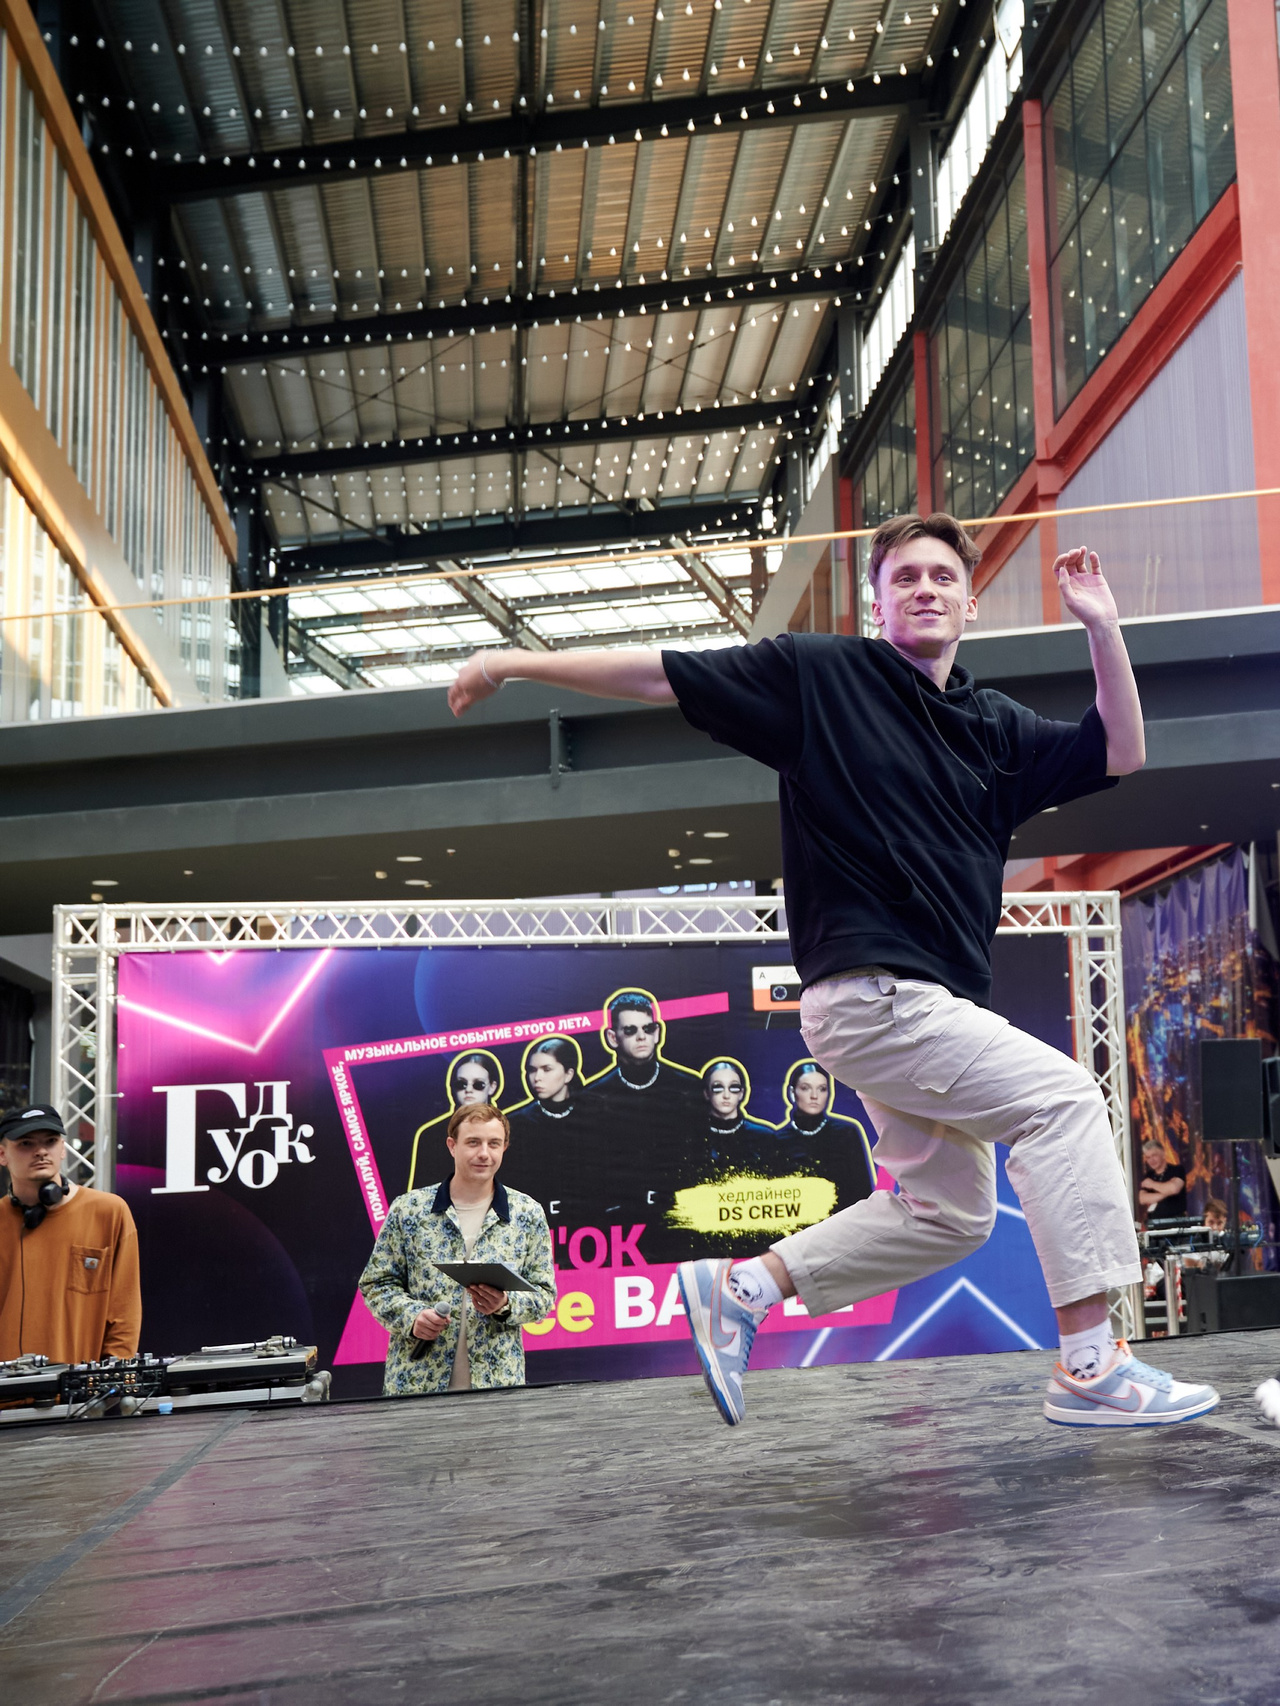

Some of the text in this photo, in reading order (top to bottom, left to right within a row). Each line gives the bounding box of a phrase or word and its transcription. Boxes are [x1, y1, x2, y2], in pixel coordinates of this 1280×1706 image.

[344, 1015, 591, 1061] МУЗЫКАЛЬНОЕ СОБЫТИЕ ЭТОГО ЛЕТА
[331, 1061, 386, 1222] ПОЖАЛУЙ, САМОЕ ЯРКОЕ,
[718, 1186, 802, 1204] хедлайнер
[718, 1202, 801, 1222] DS CREW
